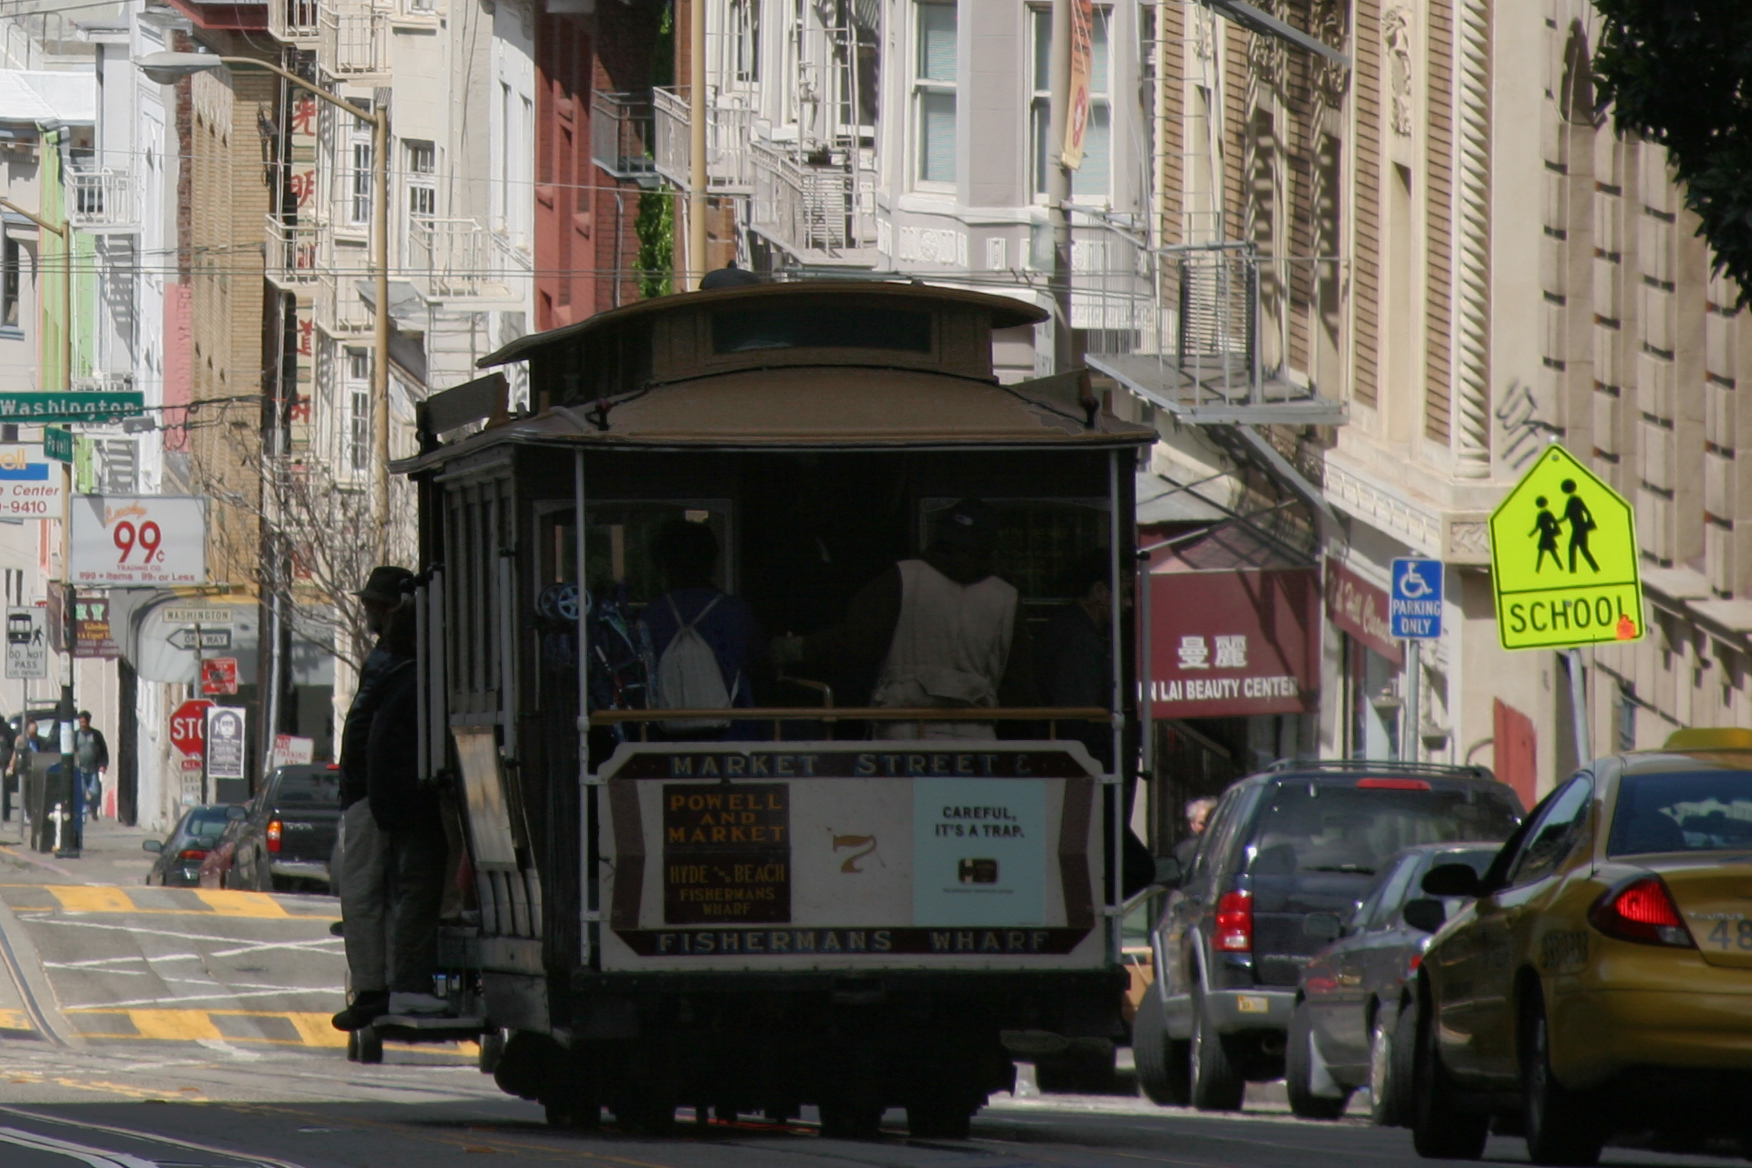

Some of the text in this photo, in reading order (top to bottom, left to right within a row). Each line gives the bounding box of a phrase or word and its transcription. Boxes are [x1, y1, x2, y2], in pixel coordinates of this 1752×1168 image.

[0, 399, 138, 421] Washington
[47, 436, 70, 455] Powell
[13, 484, 60, 496] Center
[172, 573, 195, 581] Less
[167, 611, 229, 620] WASHINGTON
[1392, 599, 1441, 617] PARKING
[1401, 617, 1432, 635] ONLY
[206, 636, 225, 644] WAY
[9, 651, 44, 659] DO NOT
[1161, 680, 1183, 702] LAI
[1186, 677, 1241, 701] BEAUTY
[1244, 675, 1299, 698] CENTER
[172, 718, 204, 739] ST
[276, 738, 289, 748] NO
[277, 749, 308, 760] PARKING
[669, 755, 820, 777] MARKET
[853, 754, 1000, 776] STREET
[669, 794, 784, 812] POWELL
[699, 812, 756, 825] AND
[942, 805, 1018, 822] CAREFUL,
[285, 822, 313, 830] TOYOTA
[668, 826, 784, 843] MARKET
[934, 823, 1025, 838] IT'S A TRAP.
[832, 834, 878, 874] 7
[669, 865, 709, 885] HYDE
[734, 863, 786, 885] BEACH
[679, 887, 776, 903] FISHERMANS
[702, 901, 752, 916] WHARF
[656, 931, 1049, 954] FISHERMANS WHARF
